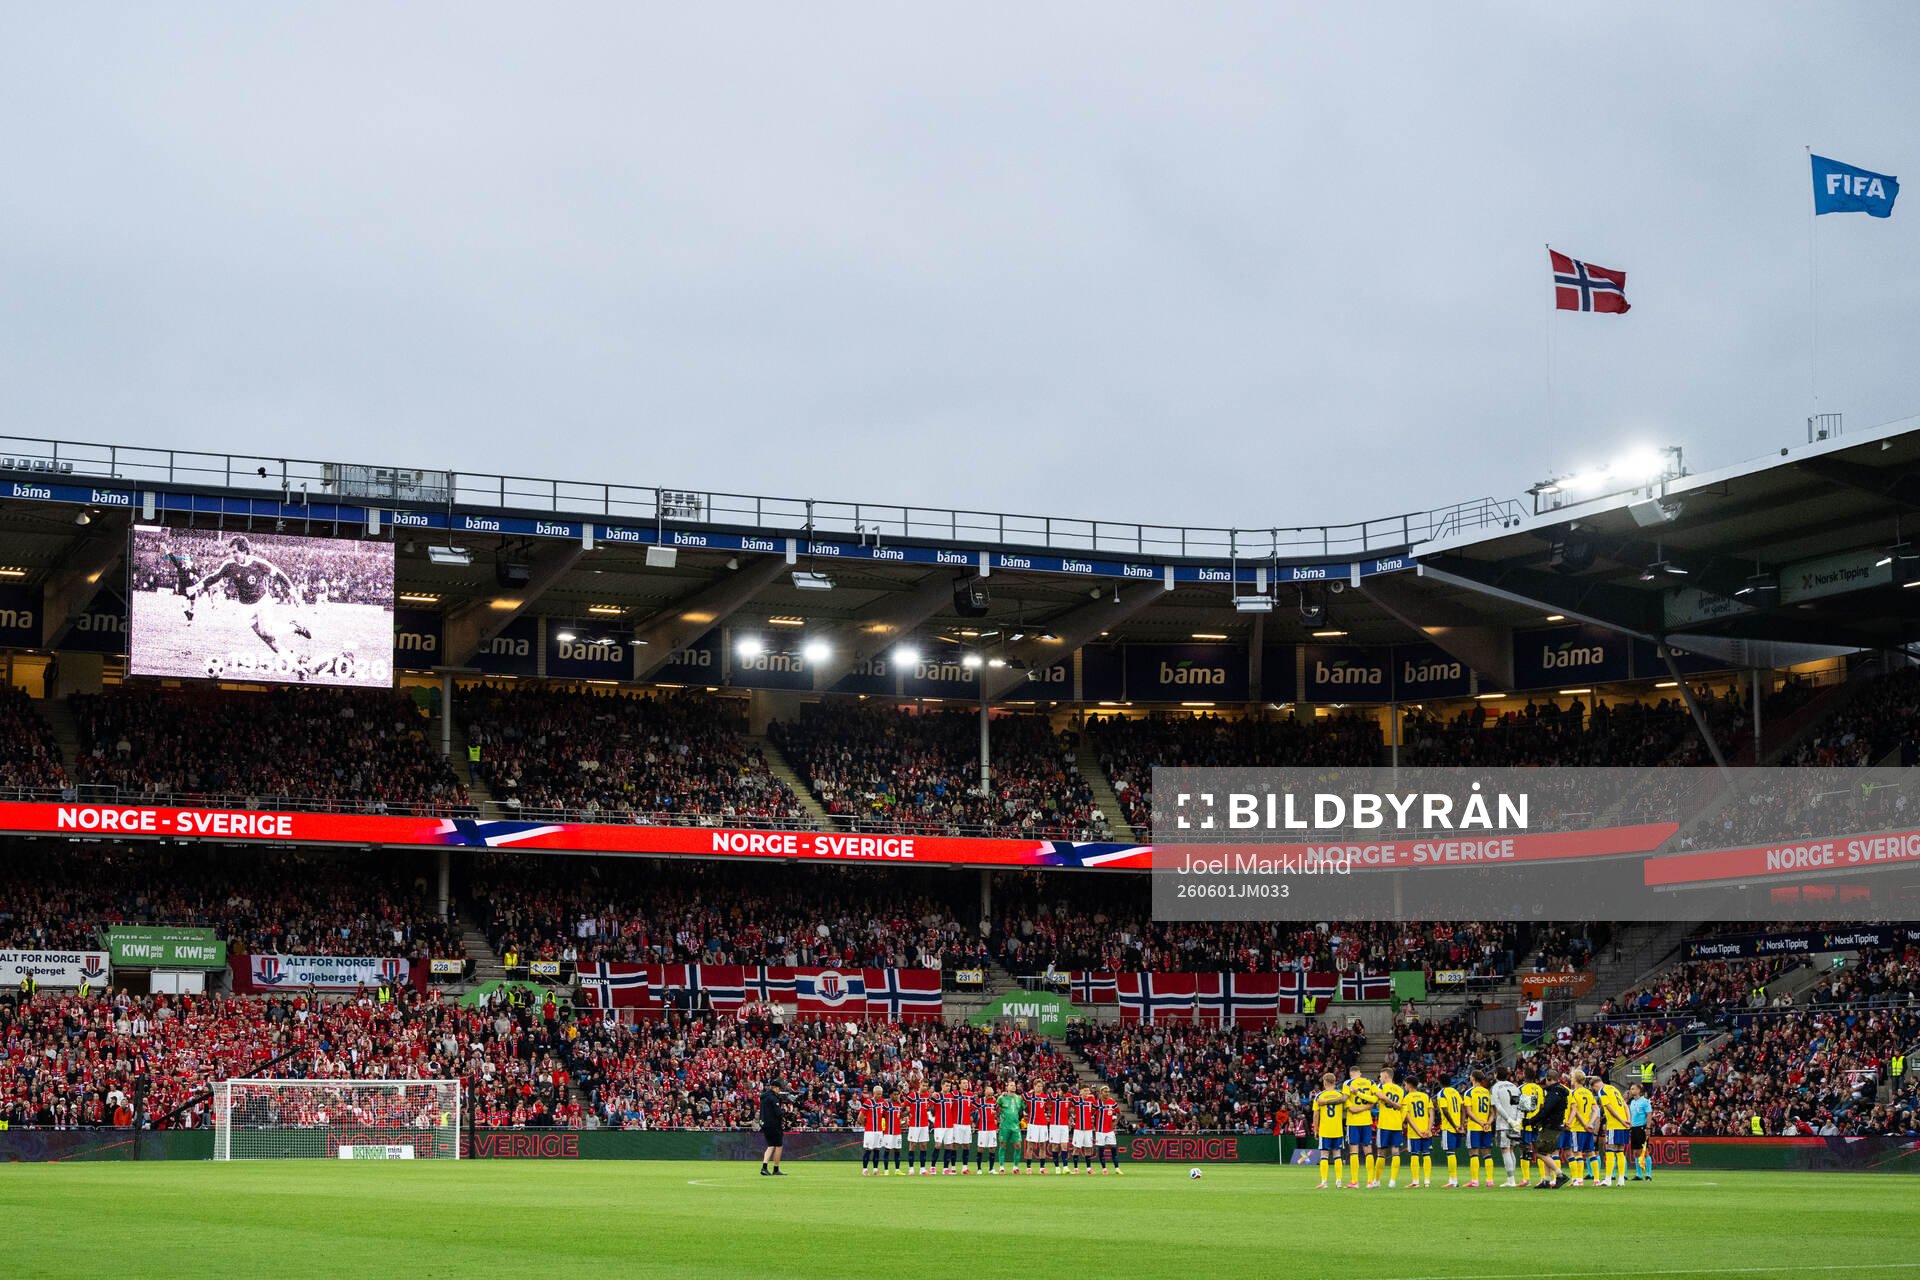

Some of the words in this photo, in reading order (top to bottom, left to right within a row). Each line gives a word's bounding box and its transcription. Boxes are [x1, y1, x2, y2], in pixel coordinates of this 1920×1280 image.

[1826, 173, 1886, 200] FIFA
[1815, 572, 1838, 585] Norsk
[57, 808, 156, 831] NORGE
[176, 812, 292, 836] SVERIGE
[712, 832, 797, 855] NORGE
[814, 836, 914, 858] SVERIGE
[1307, 845, 1396, 865] NORGE
[1413, 840, 1515, 863] SVERIGE
[1767, 844, 1834, 870] NORGE
[1848, 835, 1920, 863] SVERIG
[1766, 940, 1785, 950] Norsk
[1835, 935, 1854, 945] Norsk
[122, 944, 149, 958] KIWI
[175, 945, 203, 959] KIWI
[1700, 945, 1718, 955] Norsk
[0, 953, 18, 962] ALT
[21, 954, 42, 963] FOR
[45, 955, 81, 963] NORGE
[286, 958, 306, 966] ALT
[310, 958, 333, 966] FOR
[336, 958, 375, 967] NORGE
[15, 966, 65, 976] Oljeberget
[434, 963, 449, 971] 228
[543, 965, 557, 973] 229
[300, 972, 357, 983] Oljeberget
[1523, 976, 1558, 984] ARENA
[1002, 1003, 1039, 1017] KIWI
[1042, 1003, 1059, 1013] mini
[1042, 1014, 1058, 1024] pris
[1411, 1100, 1425, 1118] 18
[1451, 1096, 1459, 1113] 11
[1478, 1096, 1489, 1113] 16
[1582, 1096, 1588, 1113] 7
[458, 1134, 579, 1157] SVERIGE
[1131, 1138, 1238, 1160] SVERIGE
